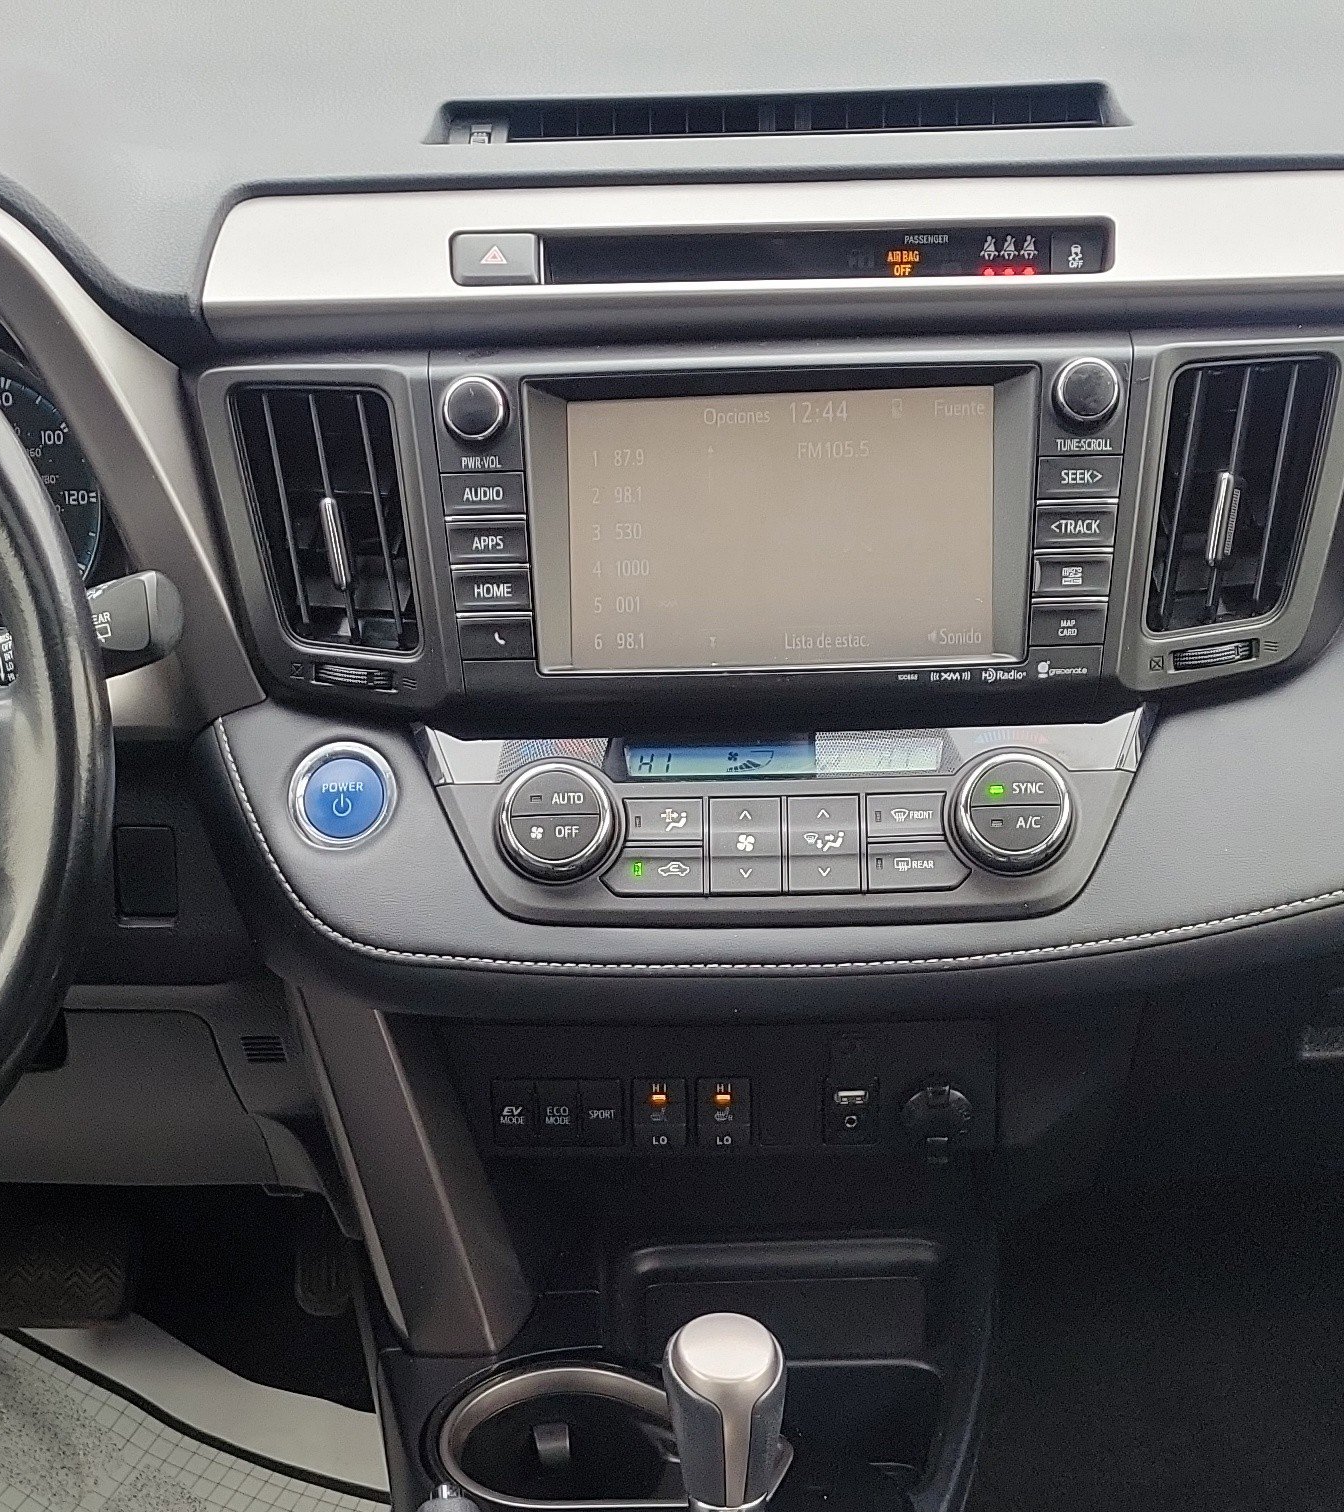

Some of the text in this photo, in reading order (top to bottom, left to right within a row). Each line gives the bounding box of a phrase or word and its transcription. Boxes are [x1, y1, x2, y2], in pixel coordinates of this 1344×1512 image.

[904, 234, 949, 244] PASSENGER
[902, 250, 920, 262] BAG
[893, 264, 912, 276] OFF
[1068, 260, 1084, 269] OFF
[702, 400, 985, 427] Opciones 12:44 Fuente
[40, 430, 64, 445] 100
[591, 448, 645, 467] 1 87.9
[64, 490, 88, 505] 120
[463, 486, 504, 502] AUDIO
[591, 486, 643, 505] 2 98.1
[591, 522, 643, 541] 3 530
[472, 536, 504, 550] APPS
[592, 558, 651, 578] 4 1000
[474, 583, 512, 599] HOME
[593, 595, 641, 614] 5 001
[91, 611, 112, 625] EAR
[593, 628, 983, 651] 6 98.1 Lista de estac. Sonido
[322, 781, 364, 793] POWER
[1012, 781, 1045, 795] SYNC
[551, 792, 584, 805] AUTO
[909, 809, 934, 821] FRONT
[1015, 815, 1041, 830] A/C
[554, 825, 580, 838] OFF
[911, 858, 935, 870] REAR
[652, 1083, 667, 1093] HI
[716, 1083, 731, 1093] HI
[502, 1106, 523, 1116] EV
[546, 1106, 569, 1116] ECO
[588, 1109, 615, 1120] SPORT
[500, 1115, 525, 1125] MODE
[545, 1115, 570, 1126] MODE
[652, 1135, 668, 1145] LO
[716, 1135, 732, 1145] LO
